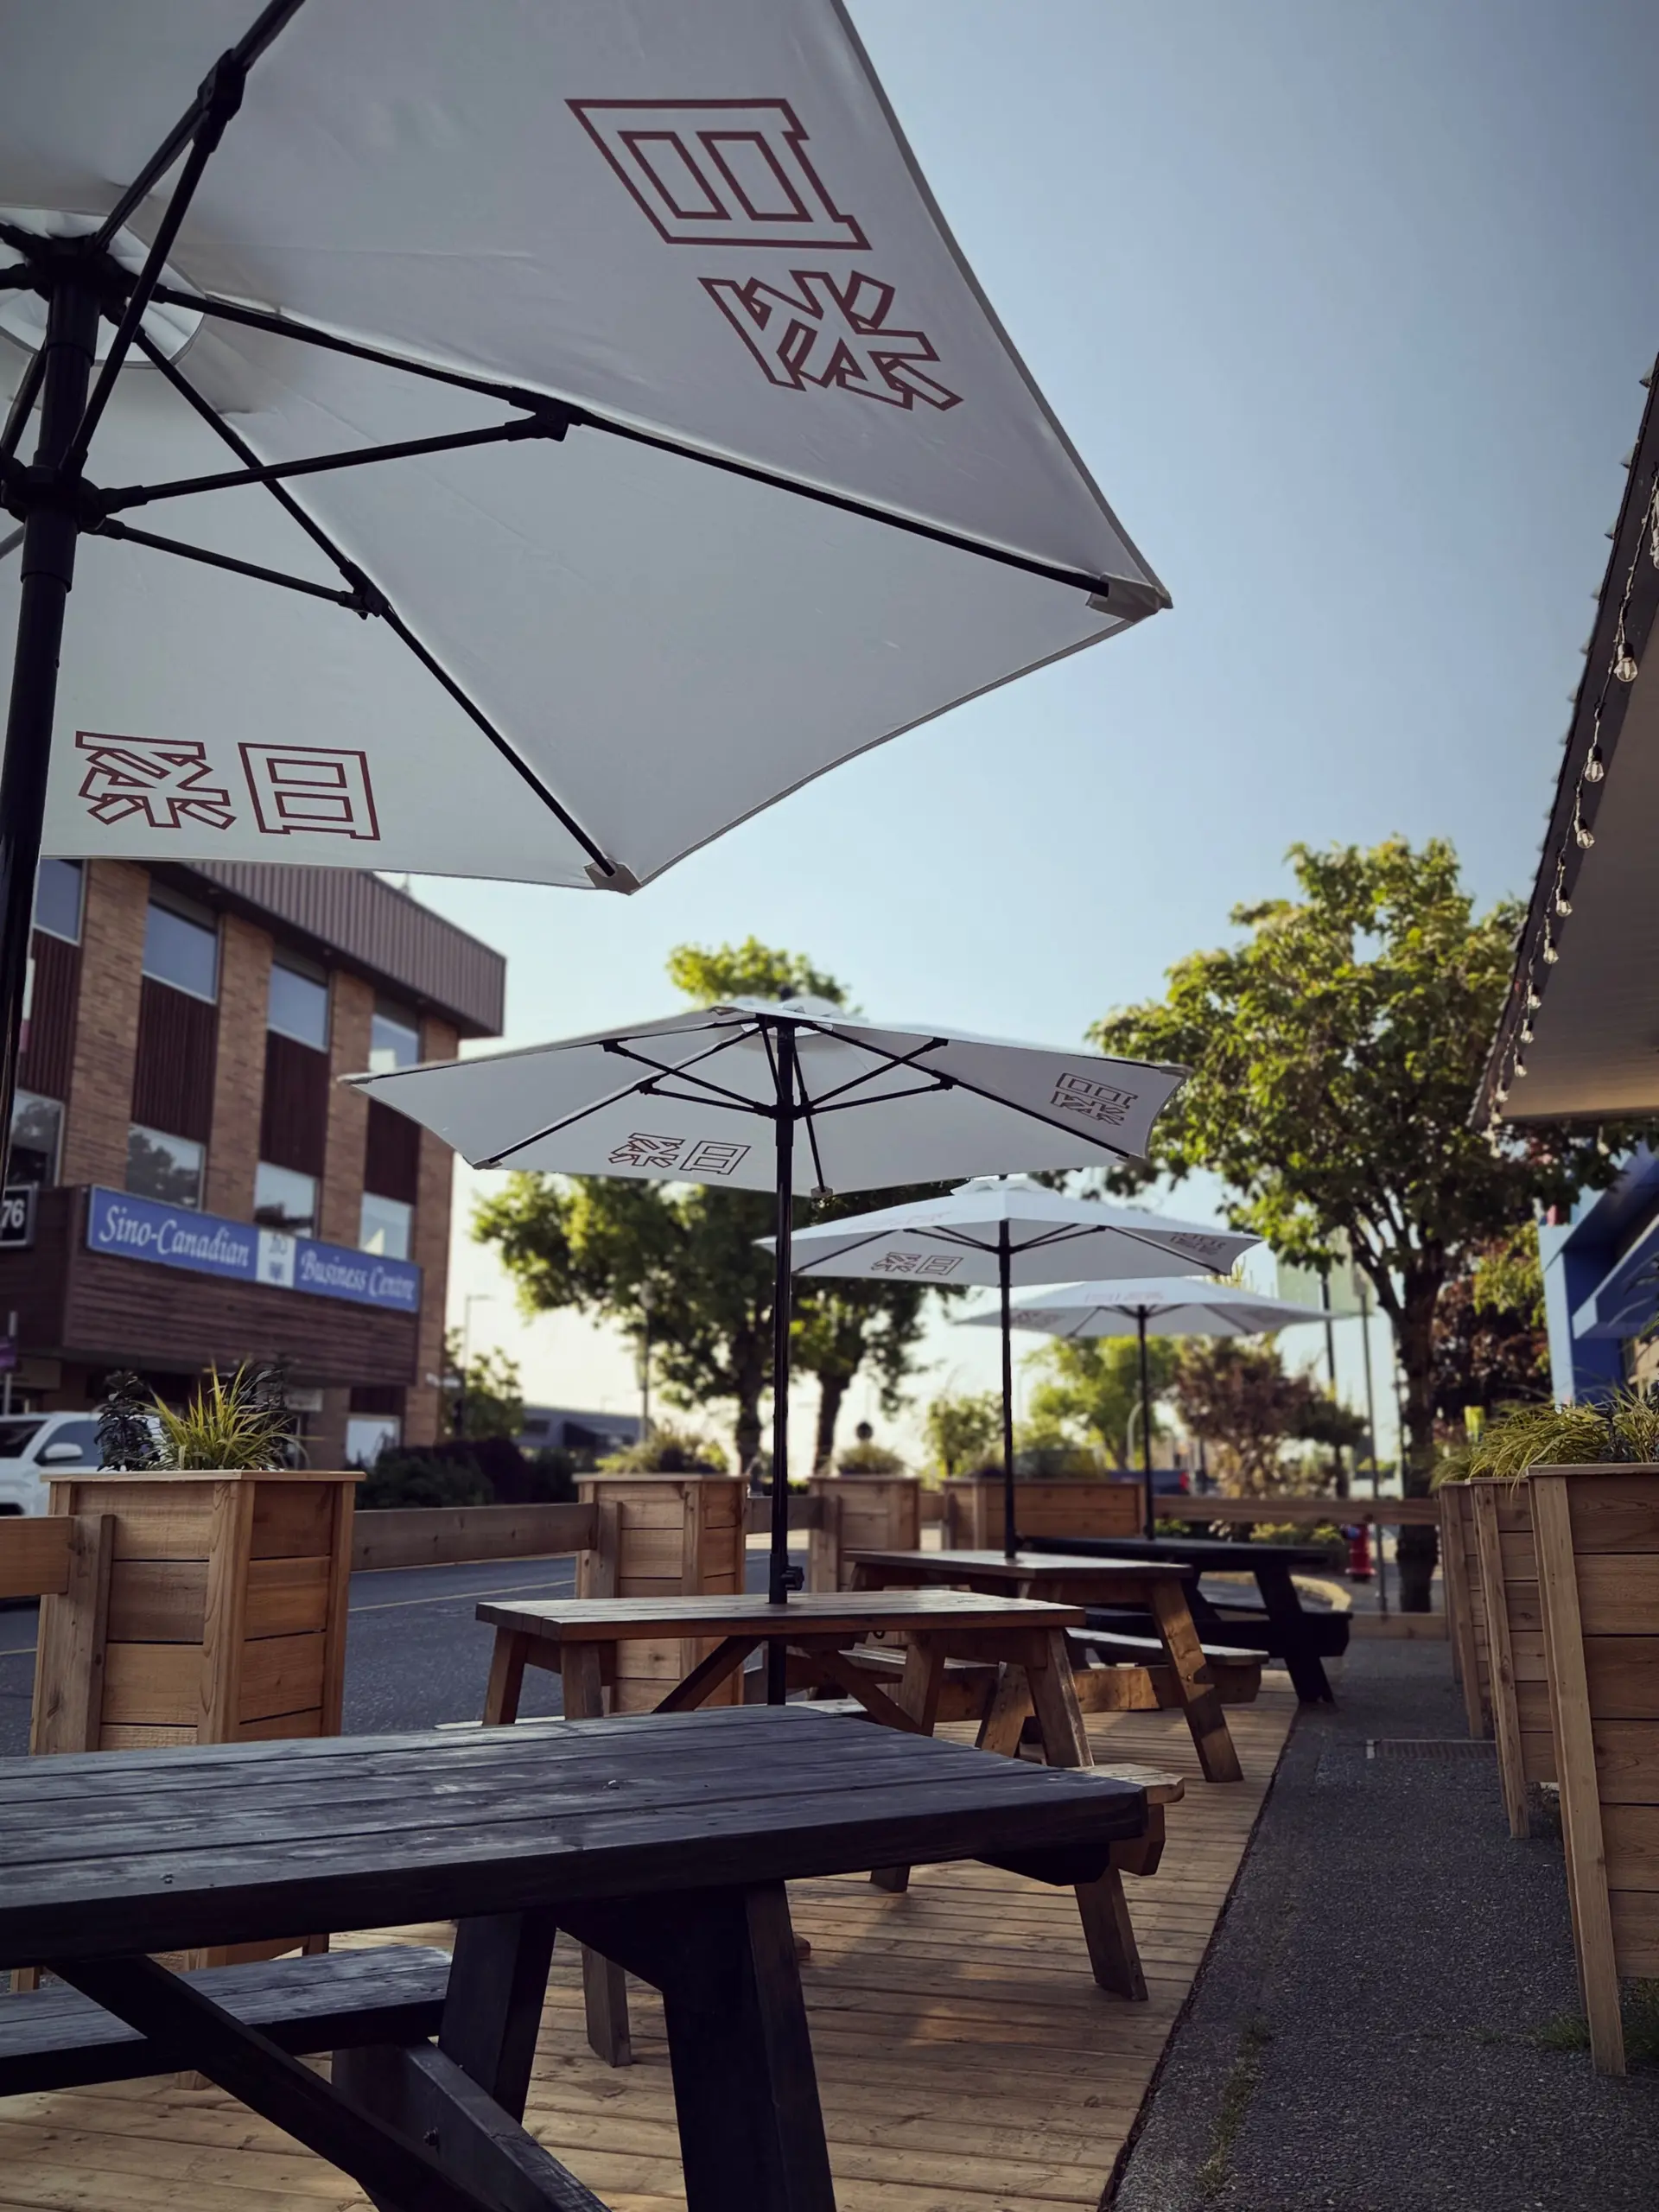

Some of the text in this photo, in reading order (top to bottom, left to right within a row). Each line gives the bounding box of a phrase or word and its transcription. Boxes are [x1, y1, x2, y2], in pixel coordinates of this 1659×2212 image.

[99, 1205, 415, 1301] Sino-Canadian Business Centre
